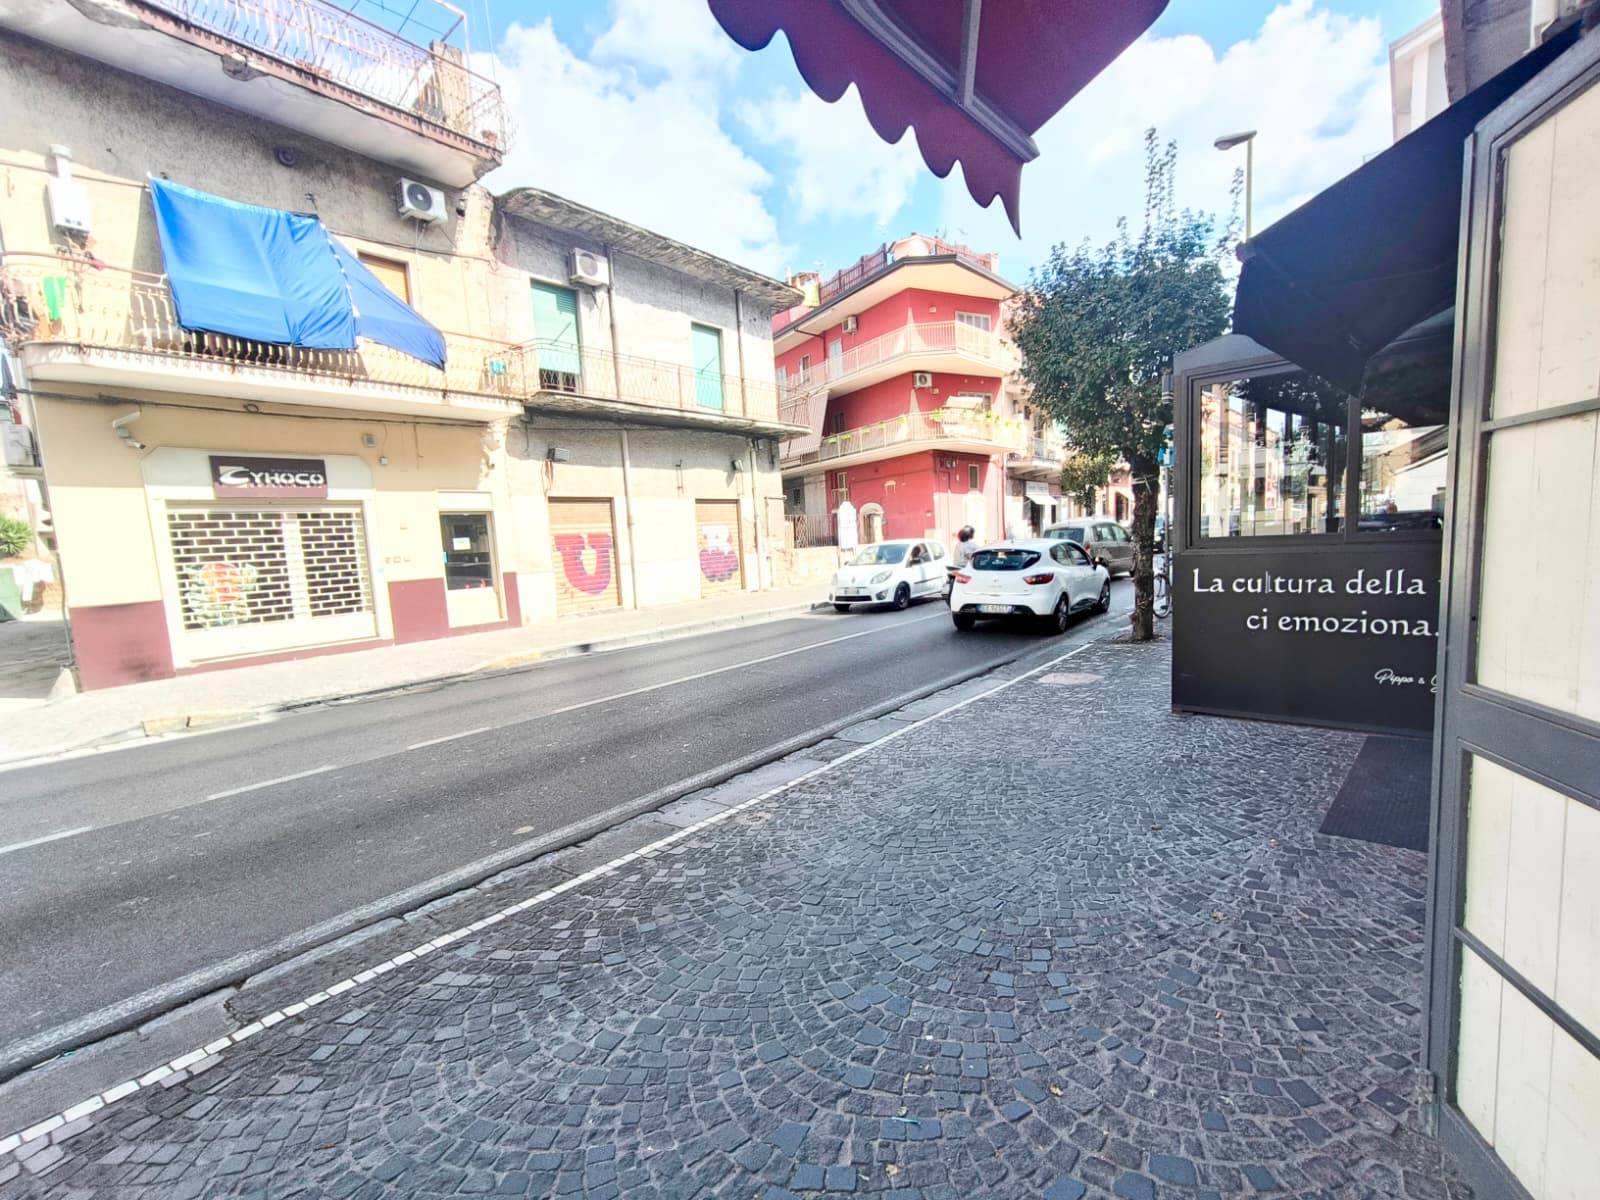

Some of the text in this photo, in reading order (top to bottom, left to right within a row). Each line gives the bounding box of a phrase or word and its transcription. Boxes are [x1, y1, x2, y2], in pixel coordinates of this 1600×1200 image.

[1193, 568, 1225, 593] La
[1232, 570, 1336, 594] cultura
[1345, 568, 1427, 595] della
[1246, 607, 1440, 636] ci emoziona.
